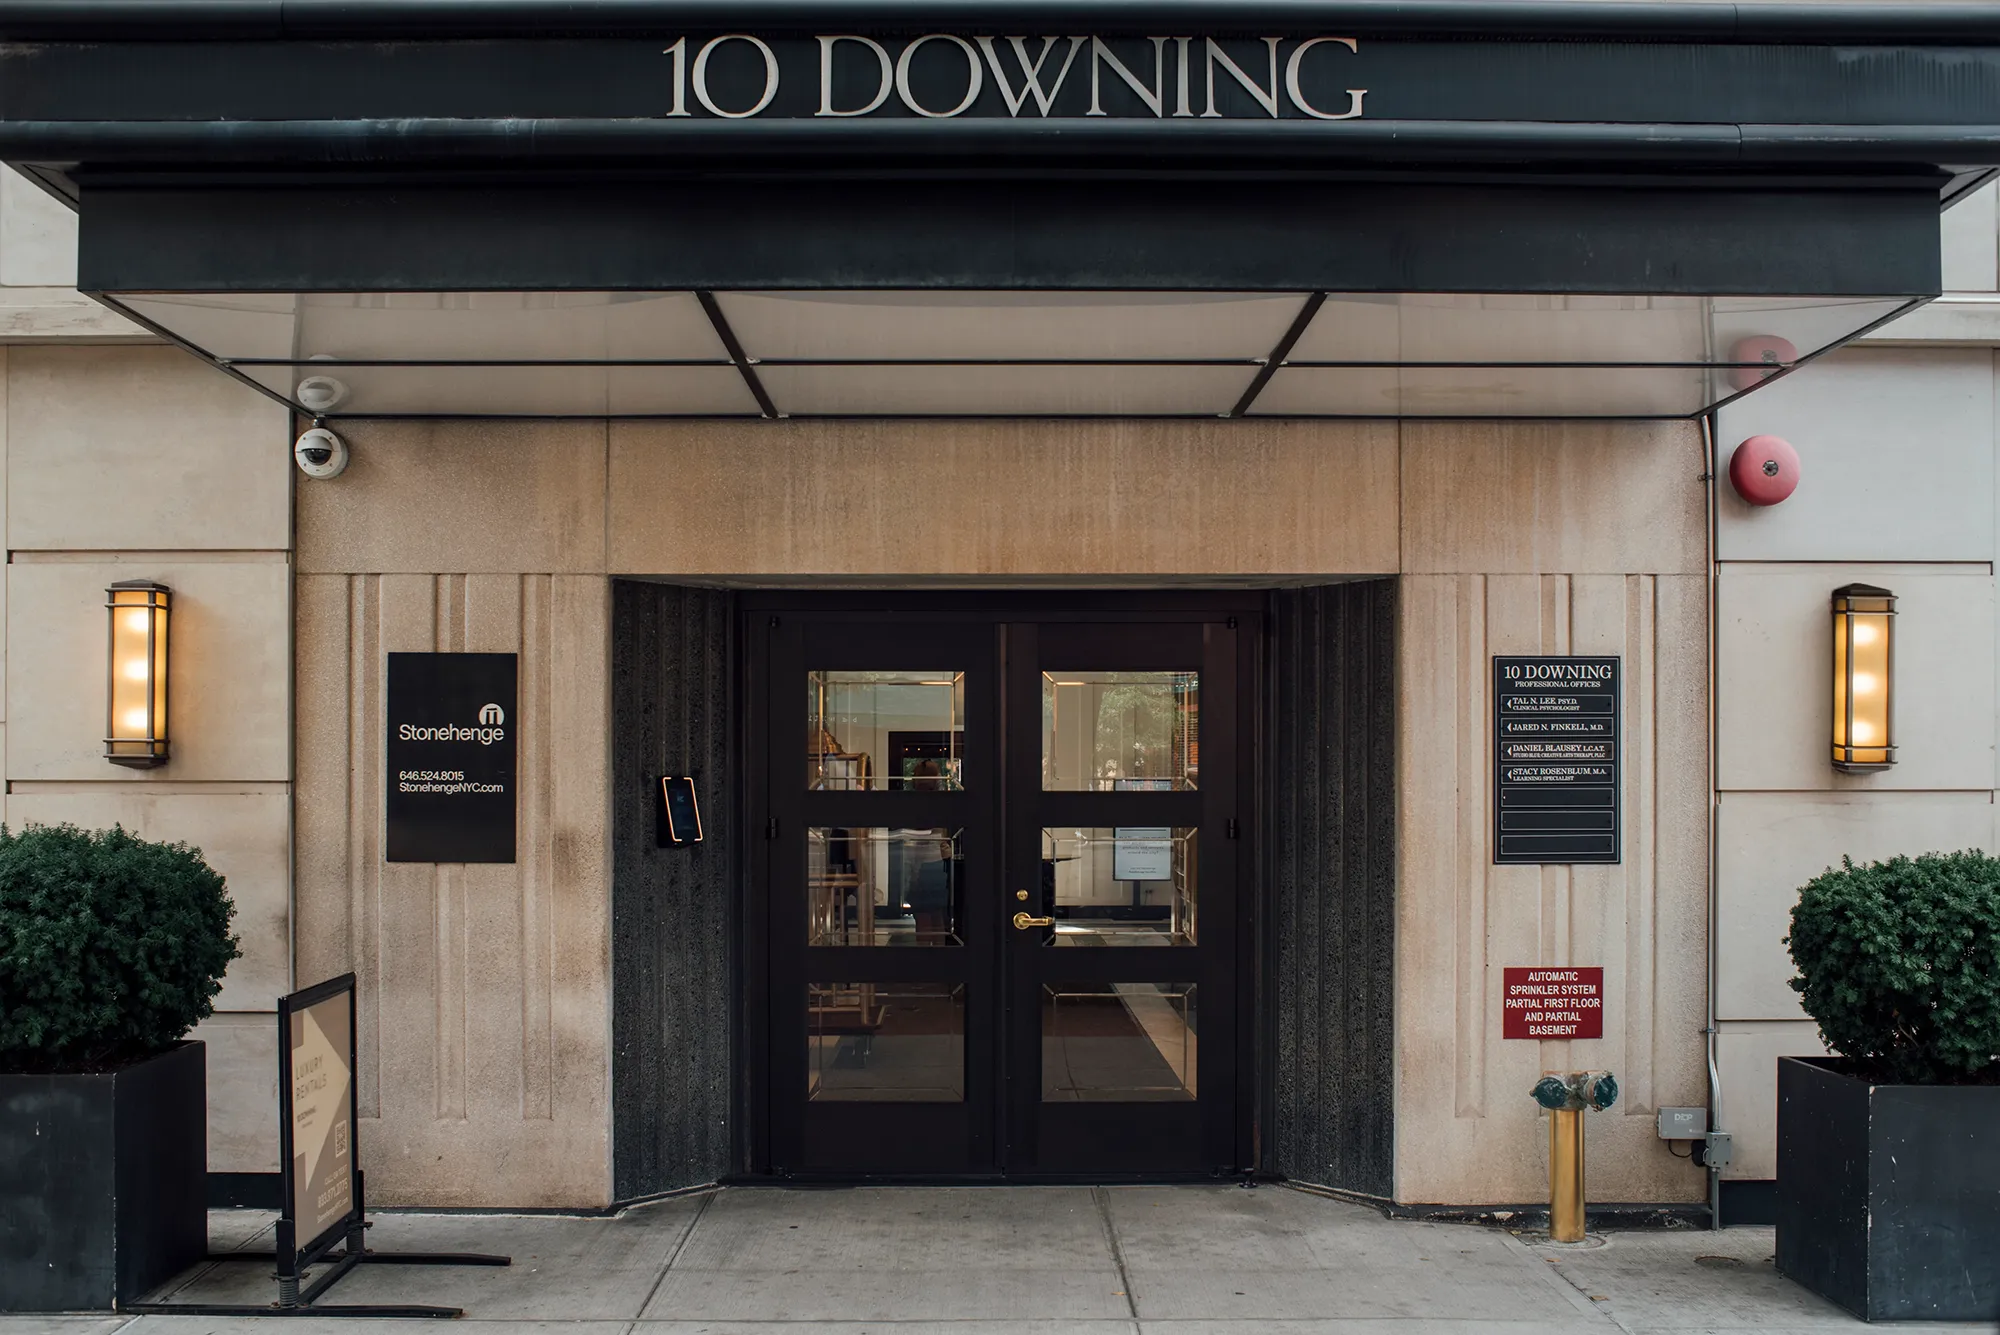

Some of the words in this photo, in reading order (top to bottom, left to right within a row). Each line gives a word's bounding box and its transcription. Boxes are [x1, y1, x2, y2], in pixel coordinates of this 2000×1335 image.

[663, 34, 780, 119] 10
[814, 33, 1368, 120] DOWNING
[1504, 665, 1520, 679] 10
[1524, 664, 1613, 680] DOWNING
[1512, 697, 1529, 705] TAL
[1512, 723, 1540, 731] JARED
[1550, 723, 1589, 732] FINKELL,
[399, 723, 504, 745] Stonehenge
[1513, 744, 1544, 752] DANIEL
[399, 770, 464, 781] 646.524.8015
[1512, 767, 1539, 775] STACY
[399, 781, 503, 794] StonehengeNYC.com
[1528, 971, 1578, 981] AUTOMATIC
[1510, 985, 1559, 995] SPRINKLER
[1561, 985, 1596, 995] SYSTEM
[1506, 998, 1542, 1008] PARTIAL
[1544, 998, 1569, 1008] FIRST
[1570, 998, 1601, 1008] FLOOR
[1524, 1012, 1544, 1021] AND
[1545, 1012, 1581, 1021] PARTIAL
[1529, 1025, 1577, 1035] BASEMENT
[296, 1054, 324, 1081] LUXURY
[296, 1073, 327, 1102] RENTALS
